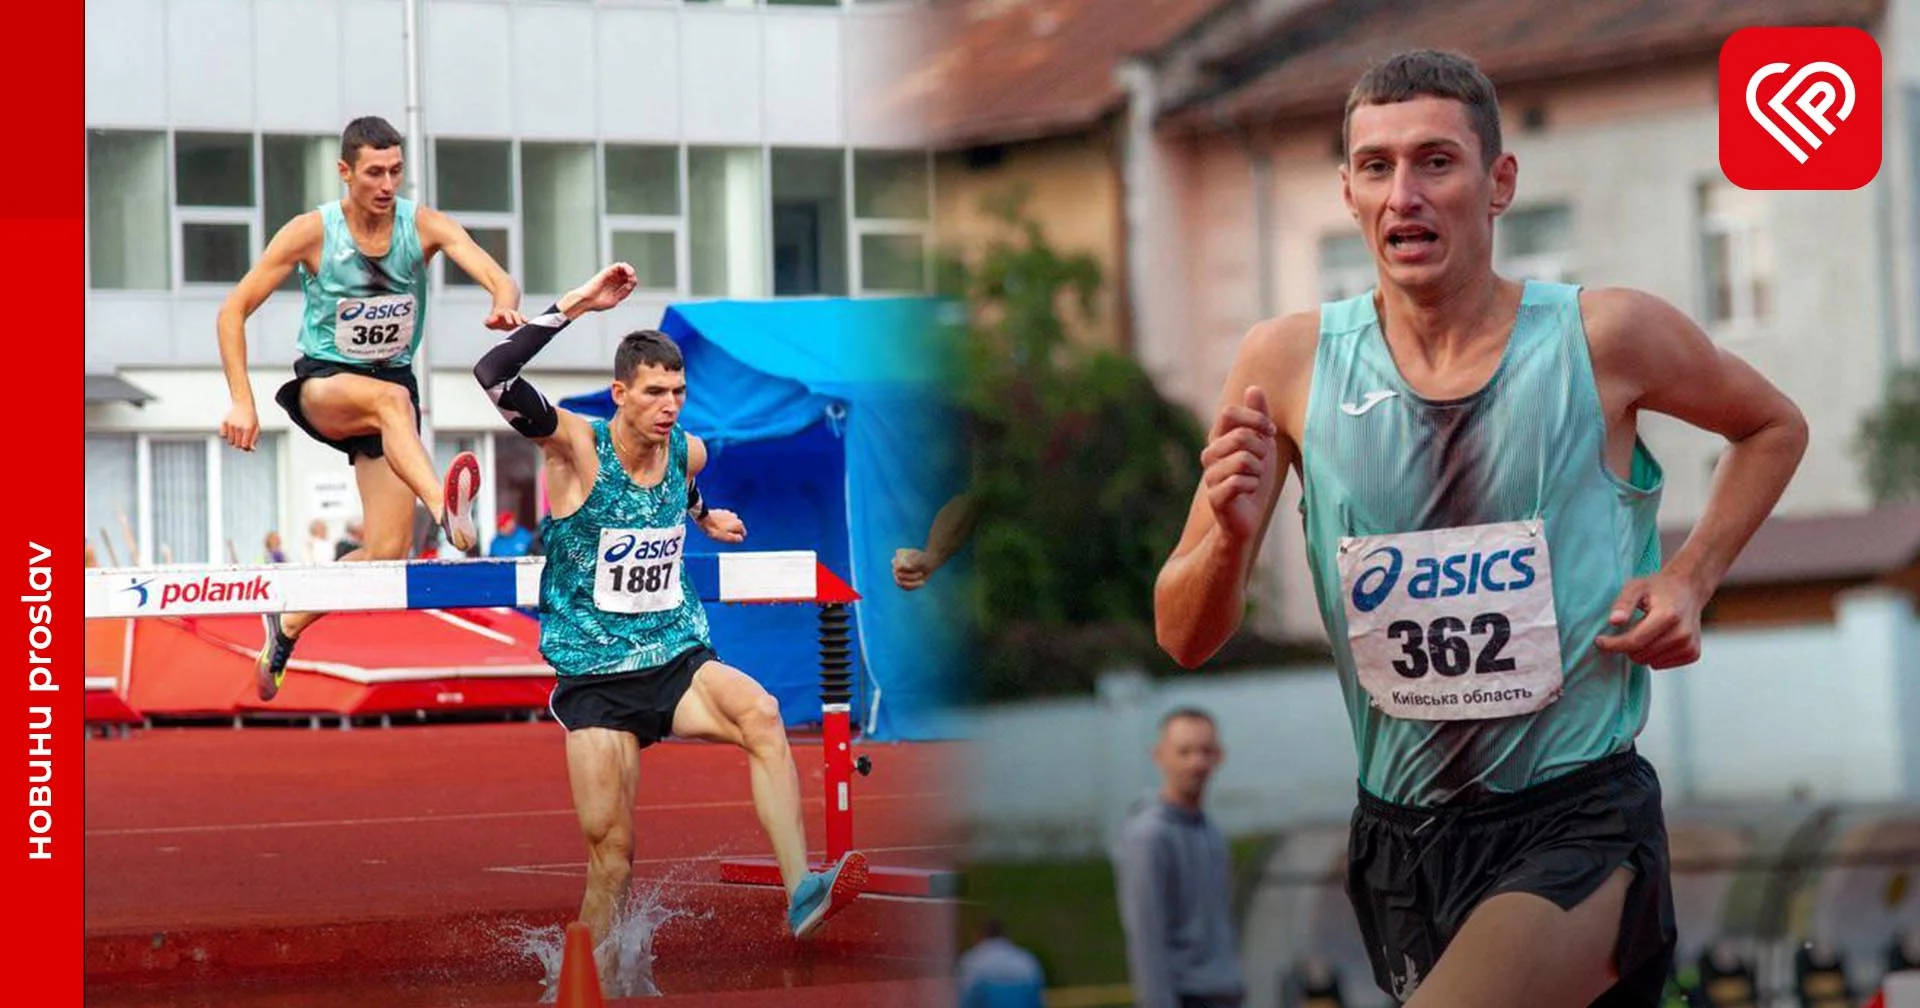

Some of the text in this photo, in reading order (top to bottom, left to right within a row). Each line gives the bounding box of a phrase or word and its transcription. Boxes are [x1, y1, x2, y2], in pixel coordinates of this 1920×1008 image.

[365, 301, 412, 320] asics
[352, 324, 400, 345] 362
[609, 562, 673, 593] 1887
[1407, 547, 1536, 599] asics
[1387, 612, 1516, 679] 362
[1392, 686, 1533, 706] Київська область
